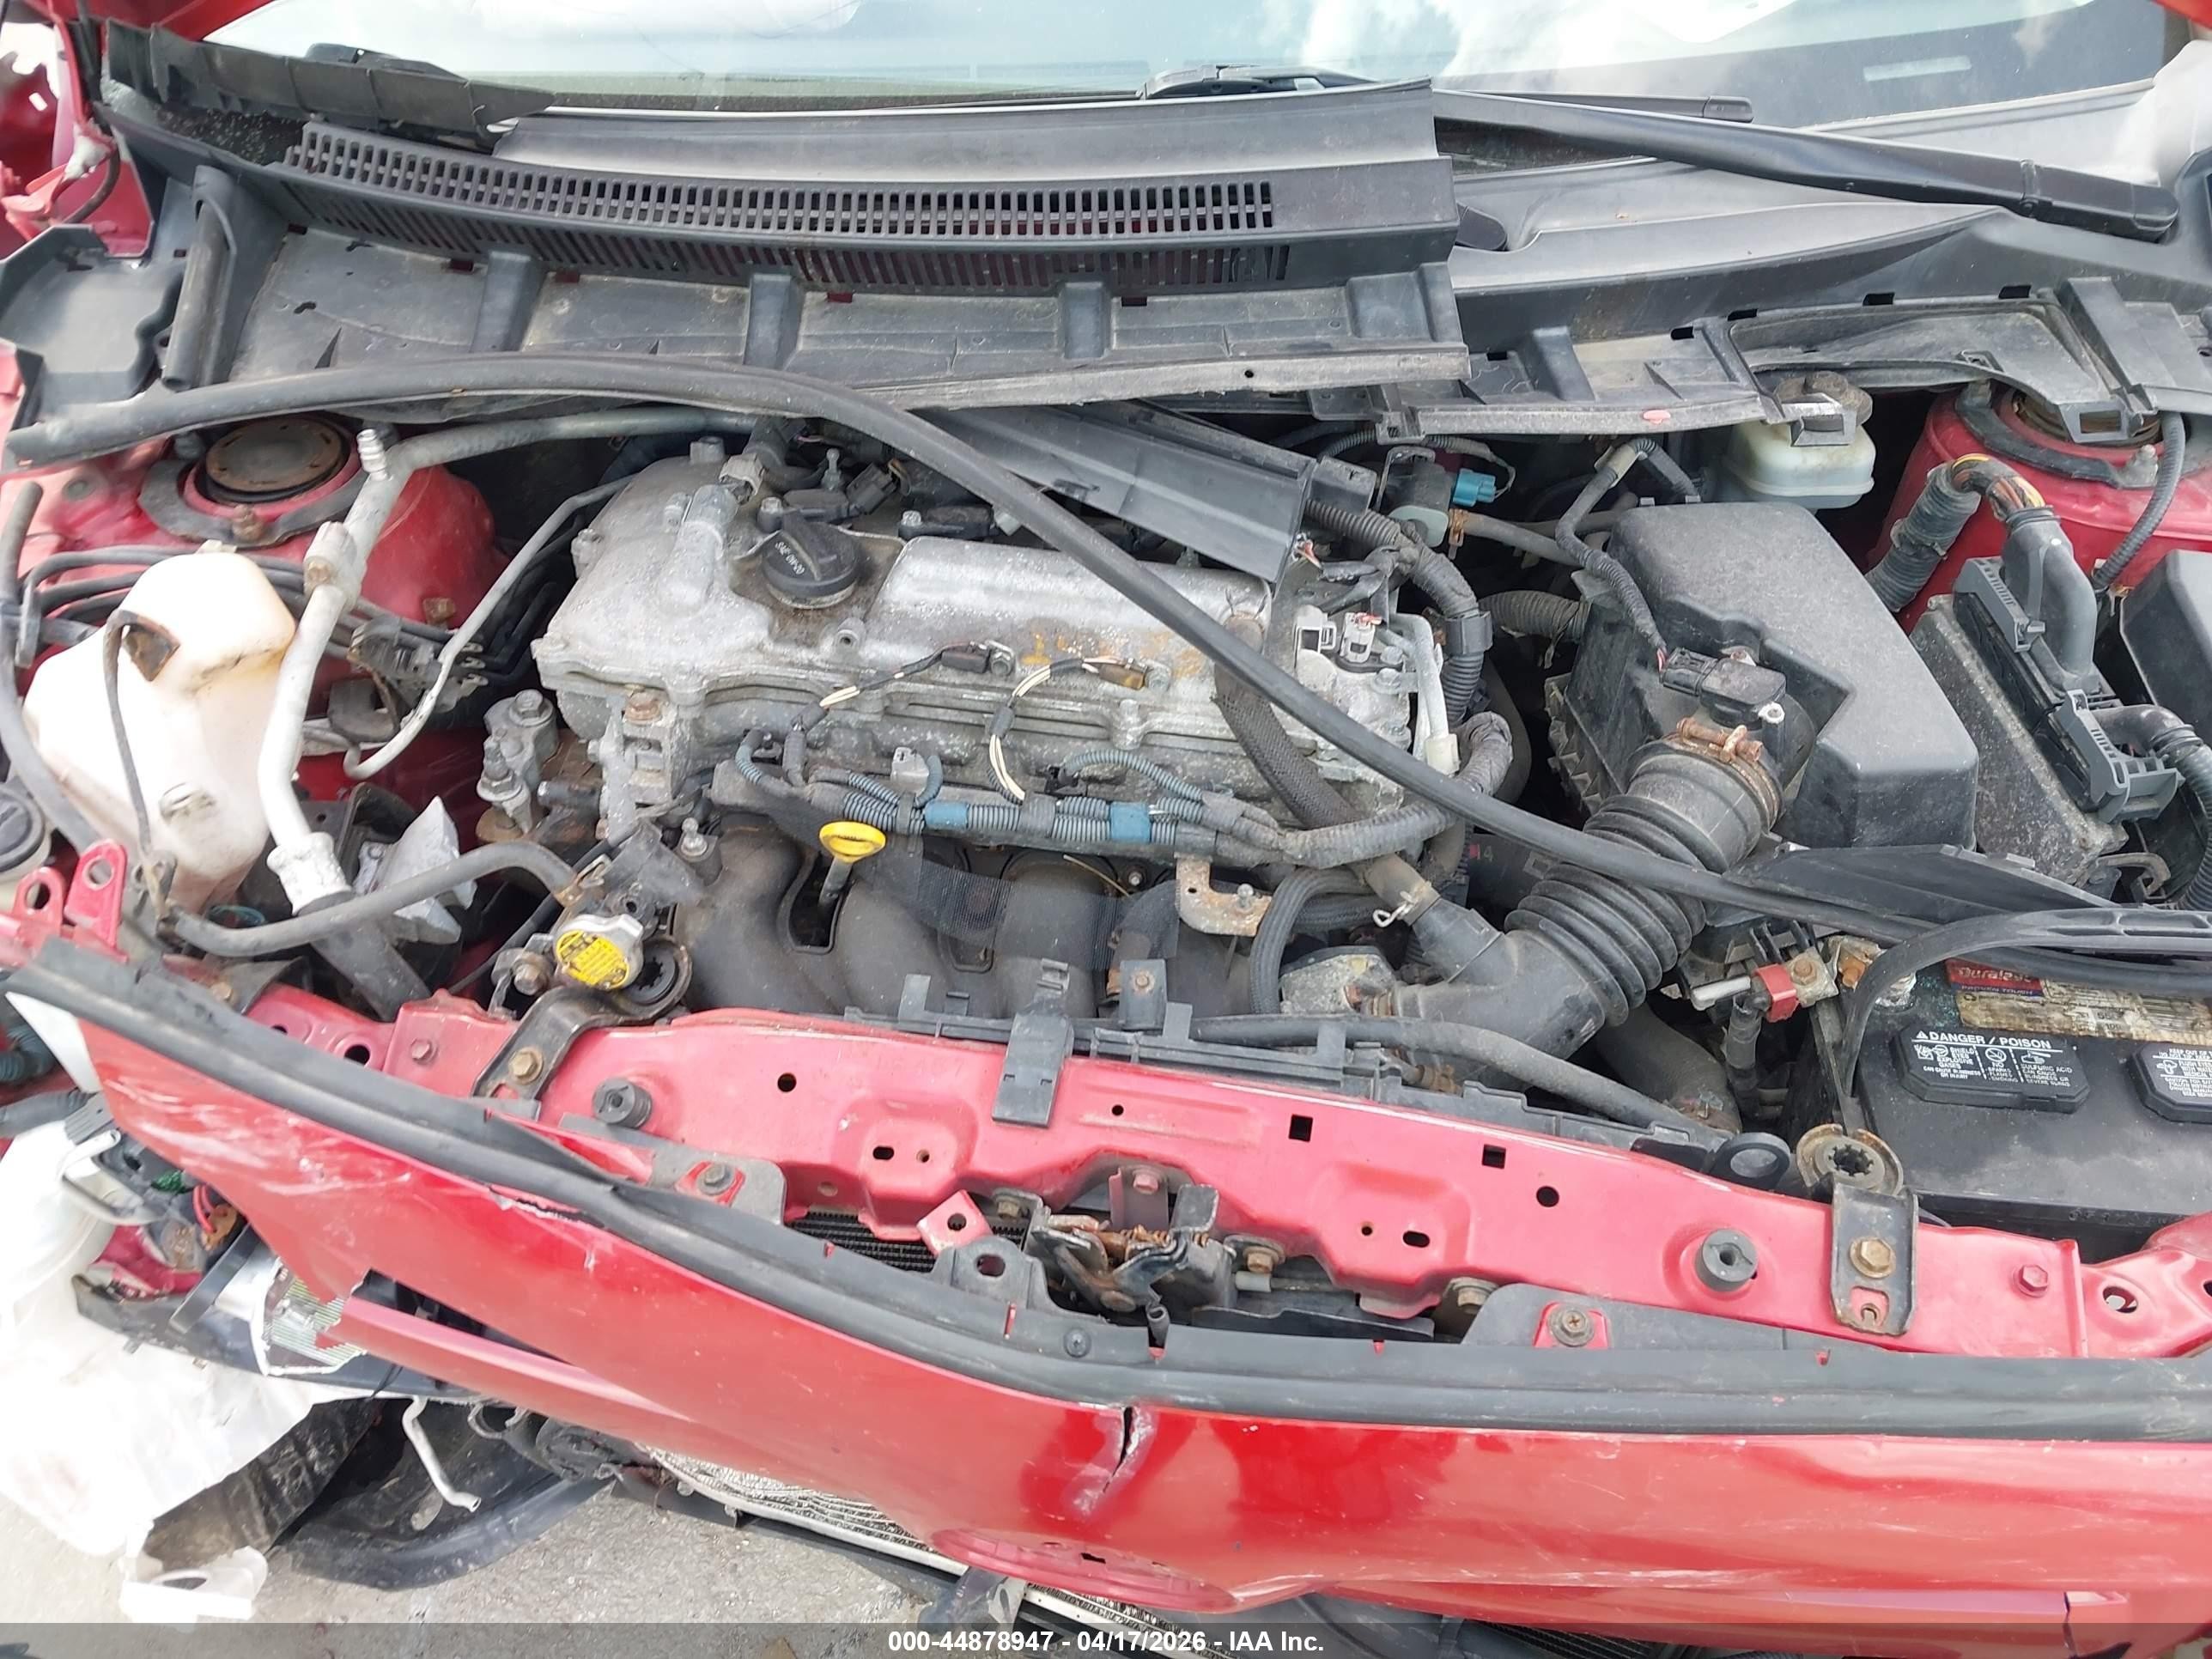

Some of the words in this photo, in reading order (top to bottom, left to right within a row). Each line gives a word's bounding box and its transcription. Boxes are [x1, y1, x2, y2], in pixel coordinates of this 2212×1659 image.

[1929, 1030, 1985, 1044] DANGER
[1989, 1036, 1996, 1045] /
[1999, 1036, 2051, 1049] POISON
[1949, 1046, 1975, 1055] SHIELD
[1937, 1056, 1973, 1065] EXPLOSIVE
[2021, 1063, 2054, 1072] SULFURIC
